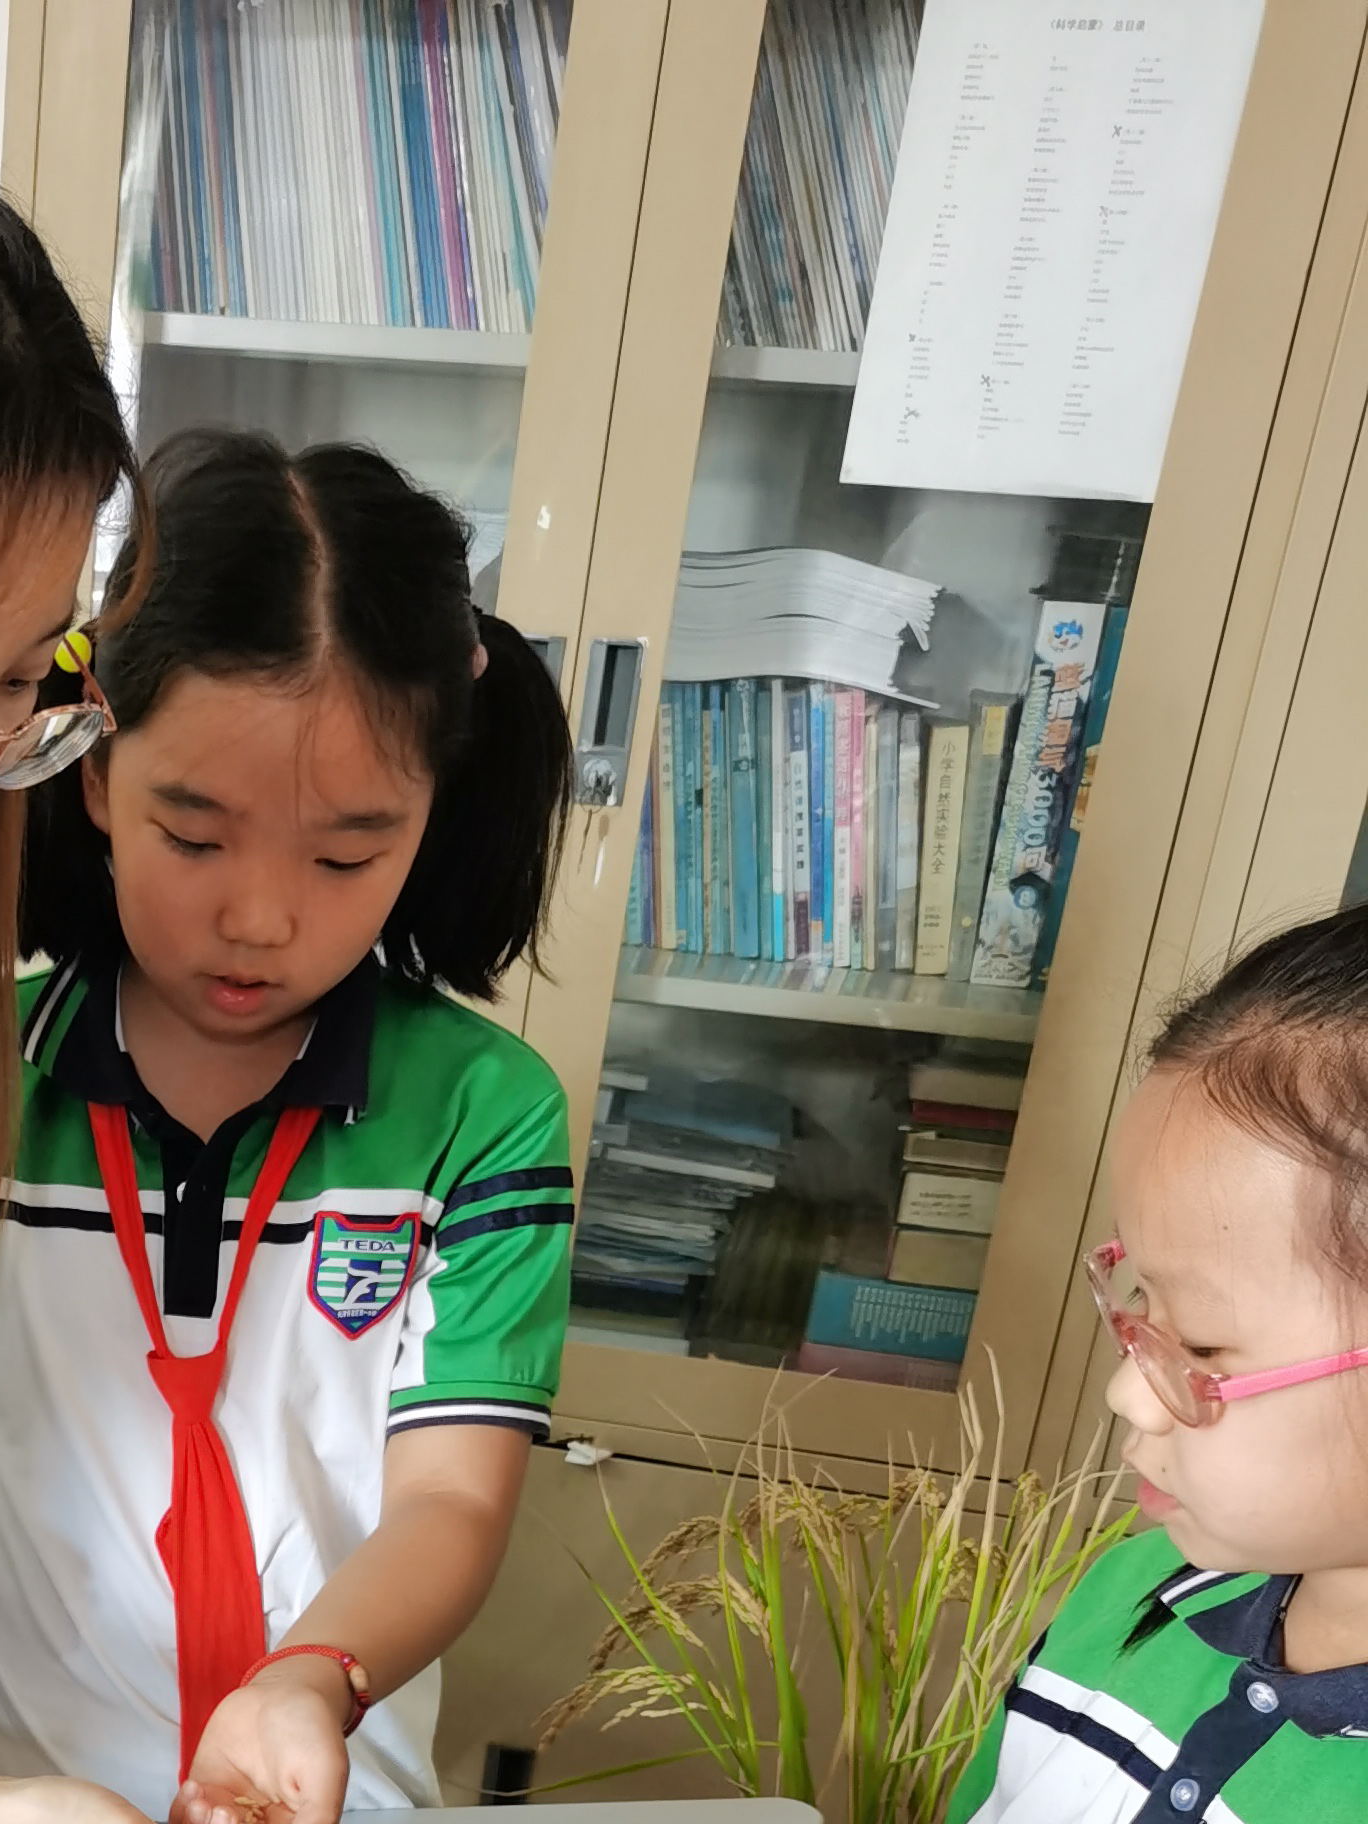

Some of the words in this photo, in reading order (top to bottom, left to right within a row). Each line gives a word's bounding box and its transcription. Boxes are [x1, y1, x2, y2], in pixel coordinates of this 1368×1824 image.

[931, 740, 957, 876] 小学自然实验大全
[339, 1239, 396, 1252] TEDA
